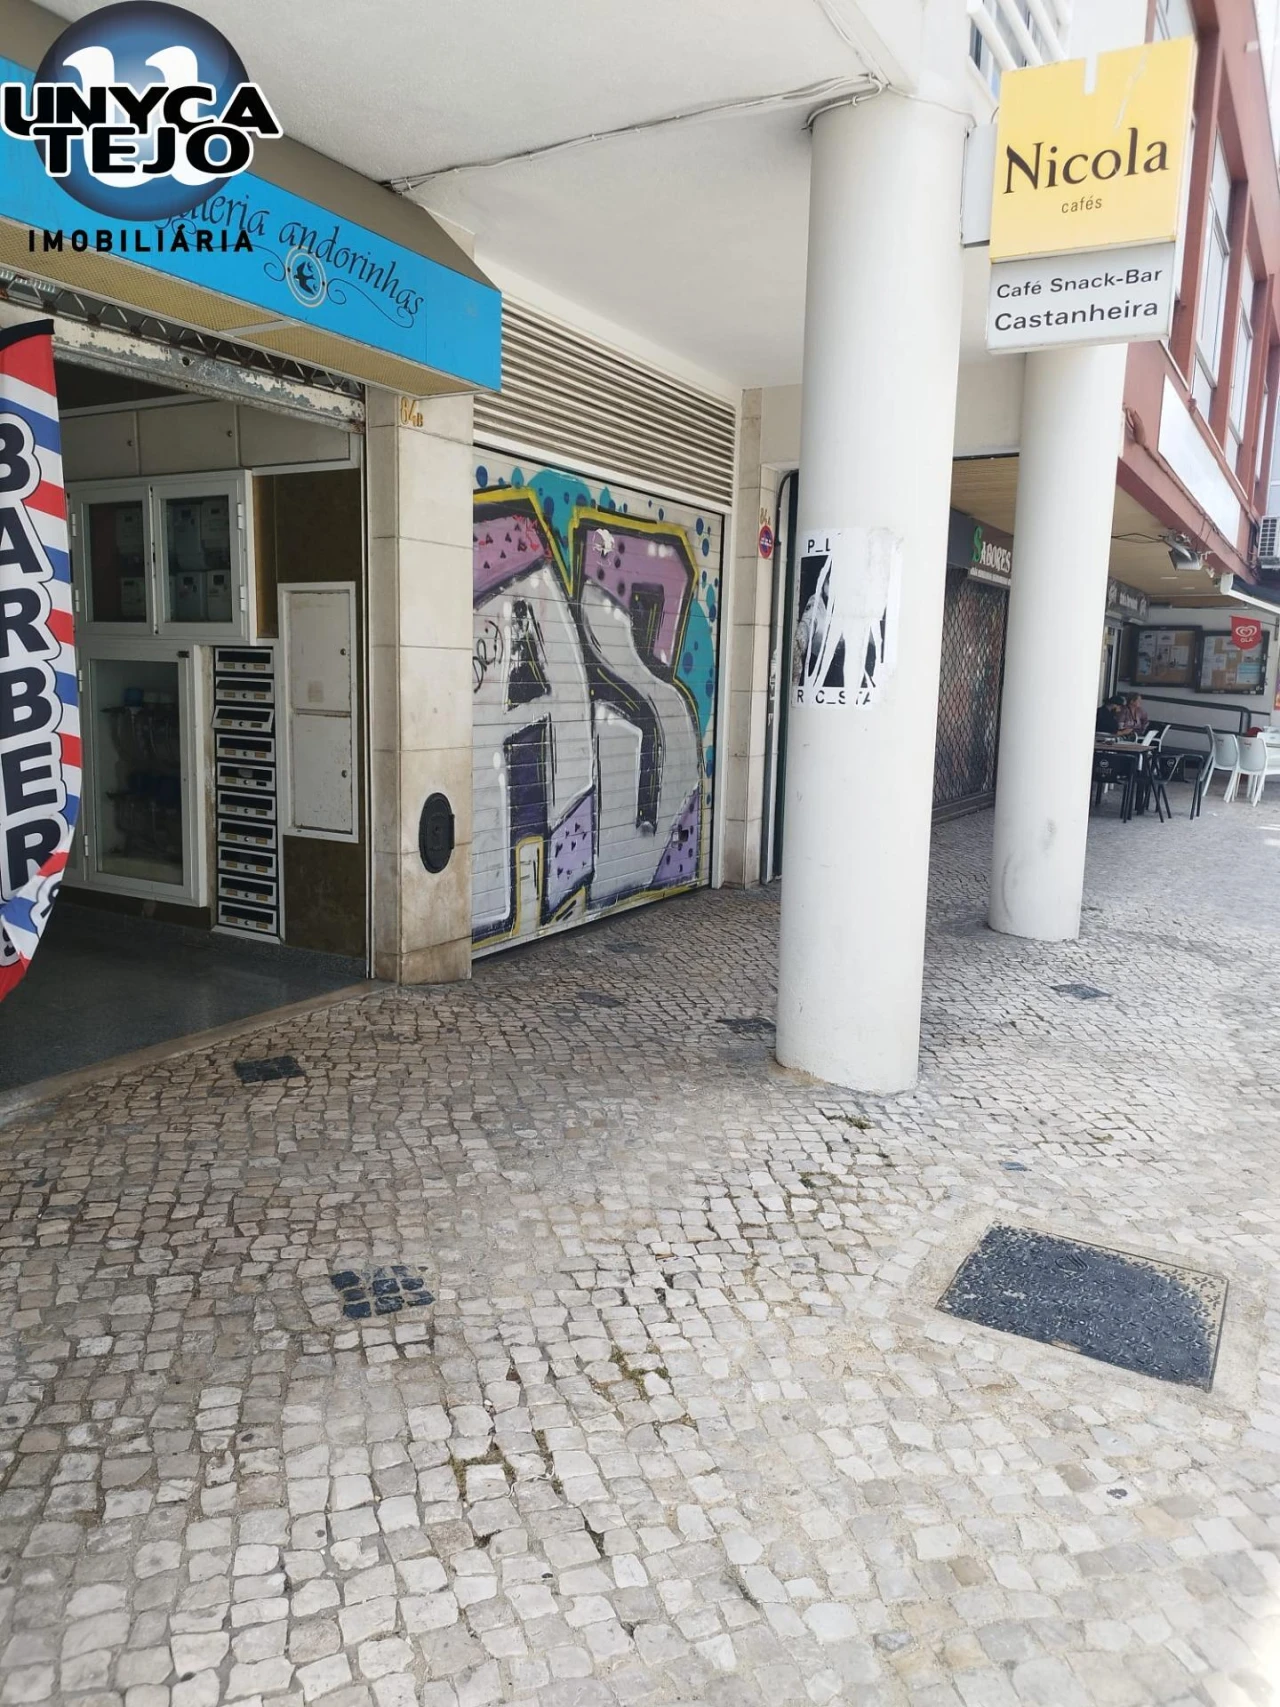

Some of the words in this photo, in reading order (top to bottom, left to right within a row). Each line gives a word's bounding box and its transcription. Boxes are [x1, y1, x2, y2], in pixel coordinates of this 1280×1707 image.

[1002, 127, 1169, 195] Nicola
[1060, 196, 1103, 214] cafés
[278, 221, 425, 316] andorinhas
[996, 280, 1042, 299] Café
[1050, 268, 1163, 293] Snack-Bar
[994, 299, 1159, 332] Castanheira
[972, 526, 1012, 573] SABORES
[0, 421, 62, 891] BARBER
